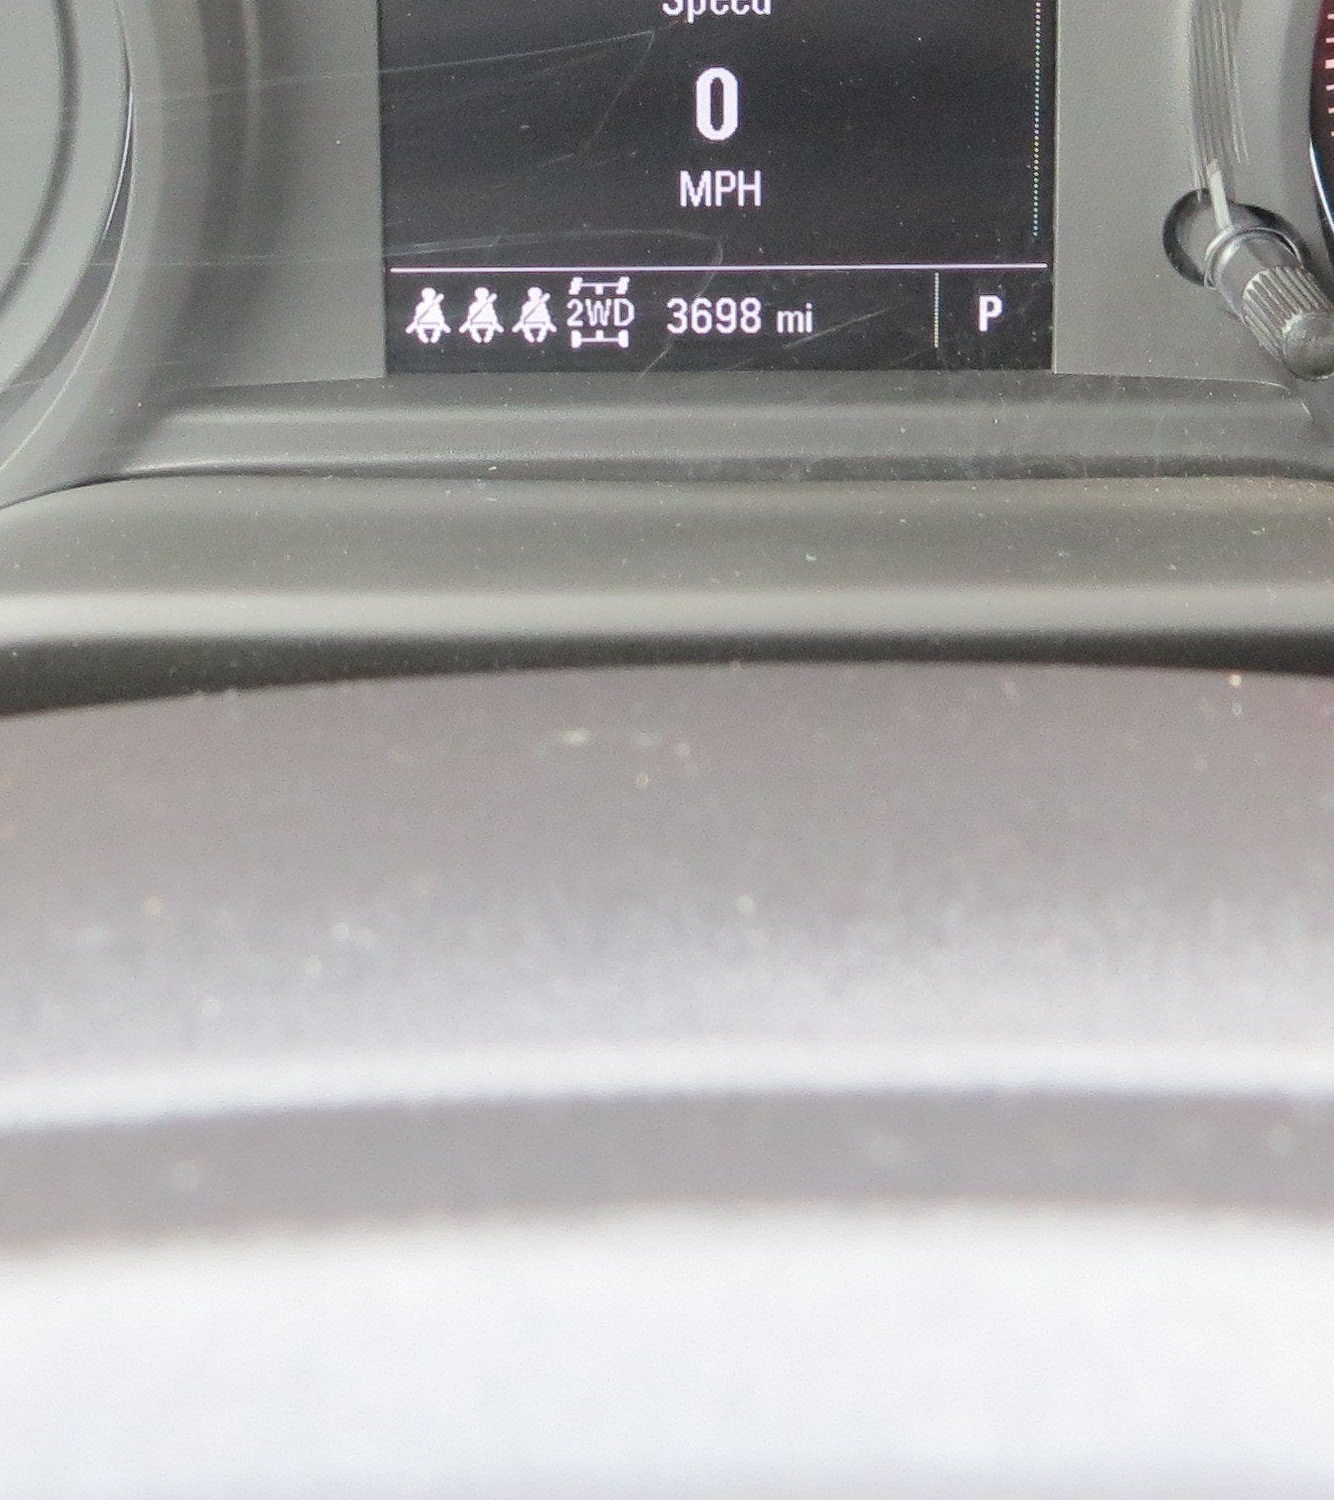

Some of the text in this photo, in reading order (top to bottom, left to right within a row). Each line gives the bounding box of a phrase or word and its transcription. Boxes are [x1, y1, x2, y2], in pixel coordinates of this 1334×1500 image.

[695, 67, 739, 141] 0
[679, 169, 762, 208] MPH
[566, 297, 635, 329] 2WD
[666, 297, 813, 334] 3698 mi
[978, 295, 1003, 332] P
